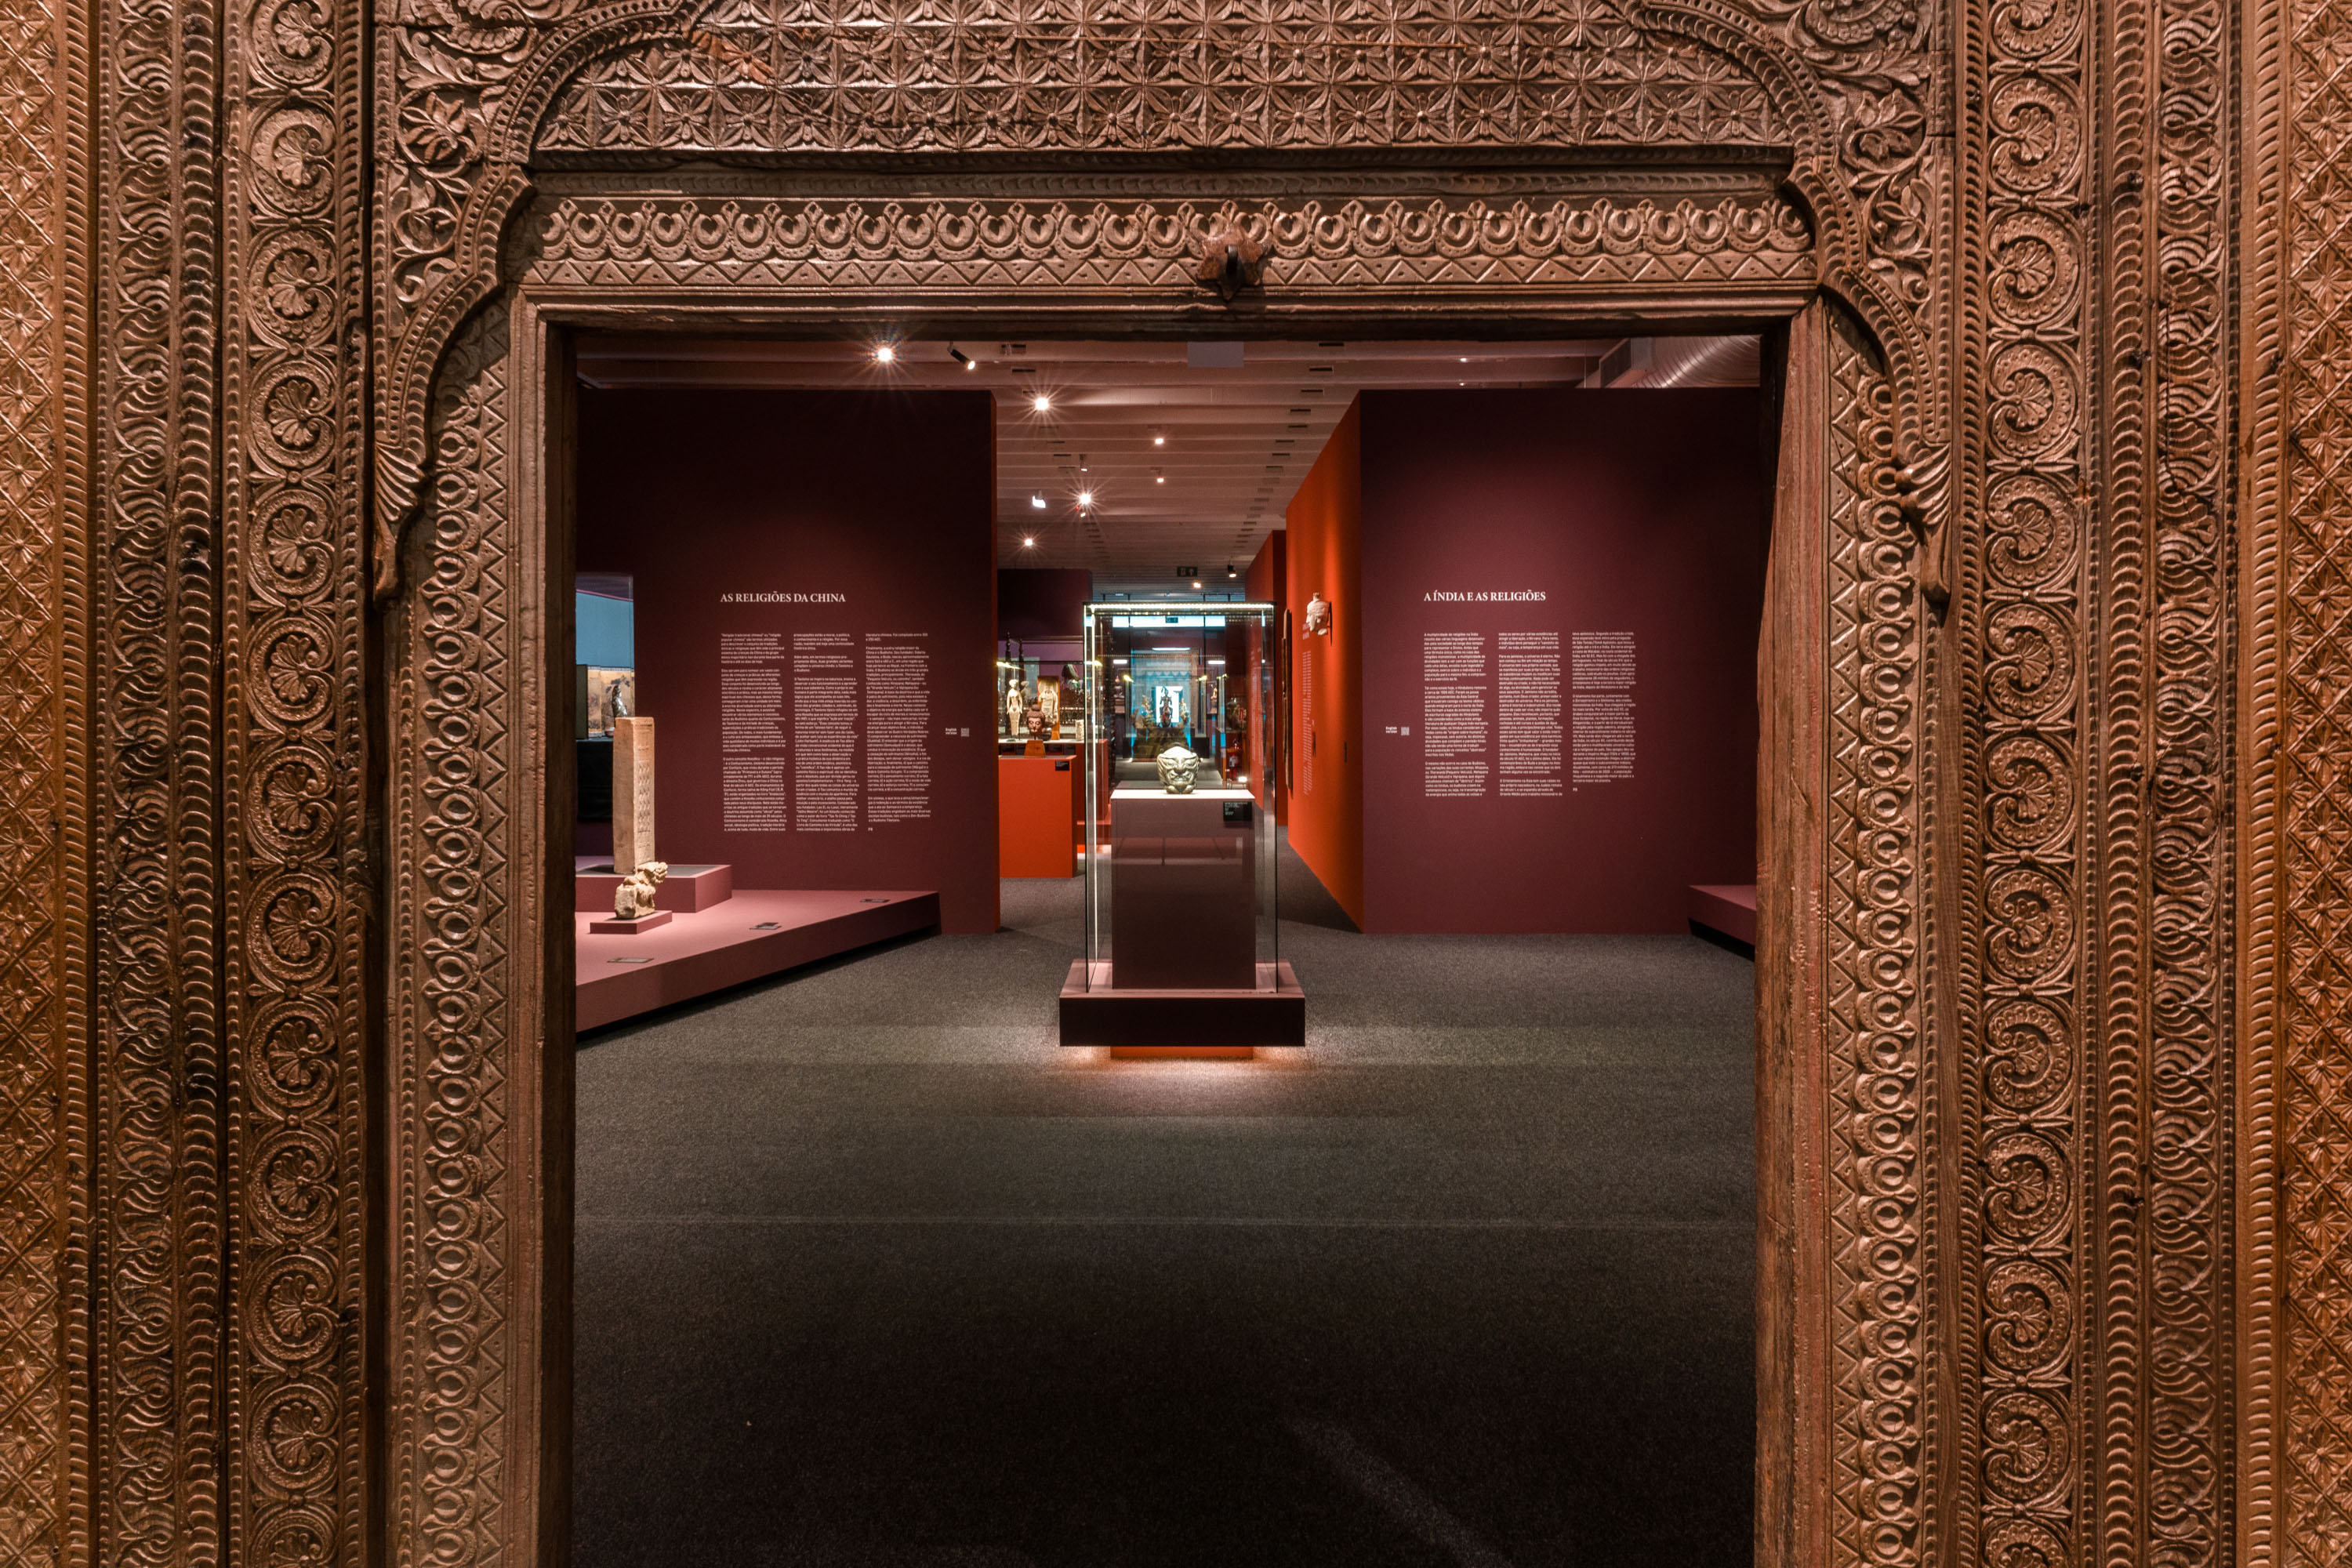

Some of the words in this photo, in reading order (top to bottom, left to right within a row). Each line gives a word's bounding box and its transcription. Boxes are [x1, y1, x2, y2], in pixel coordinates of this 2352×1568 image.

[720, 593, 733, 602] AS
[736, 591, 792, 602] RELIGIÕES
[794, 593, 808, 602] DA
[810, 593, 846, 602] CHINA
[1424, 592, 1431, 601] A
[1433, 590, 1465, 601] ÍNDIA
[1467, 592, 1473, 601] E
[1475, 592, 1488, 601] AS
[1490, 590, 1546, 601] RELIGIÕES
